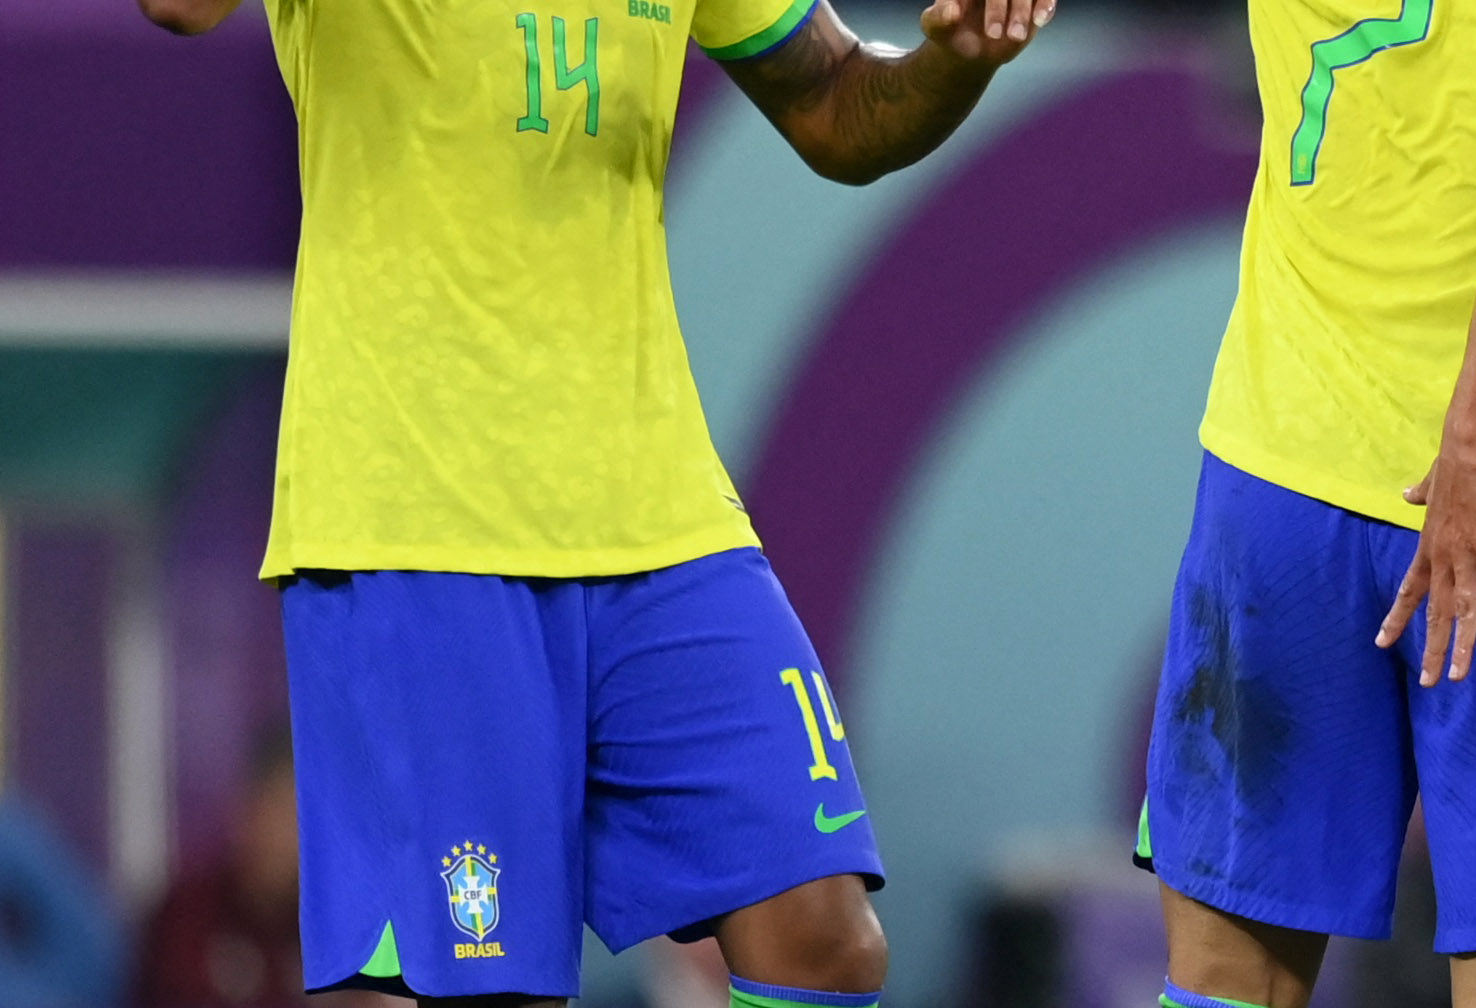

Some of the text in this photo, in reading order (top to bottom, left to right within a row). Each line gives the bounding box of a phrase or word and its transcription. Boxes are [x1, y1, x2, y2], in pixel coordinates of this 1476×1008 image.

[515, 11, 600, 139] 14
[463, 889, 482, 901] CBF
[454, 941, 506, 960] BRASIL
